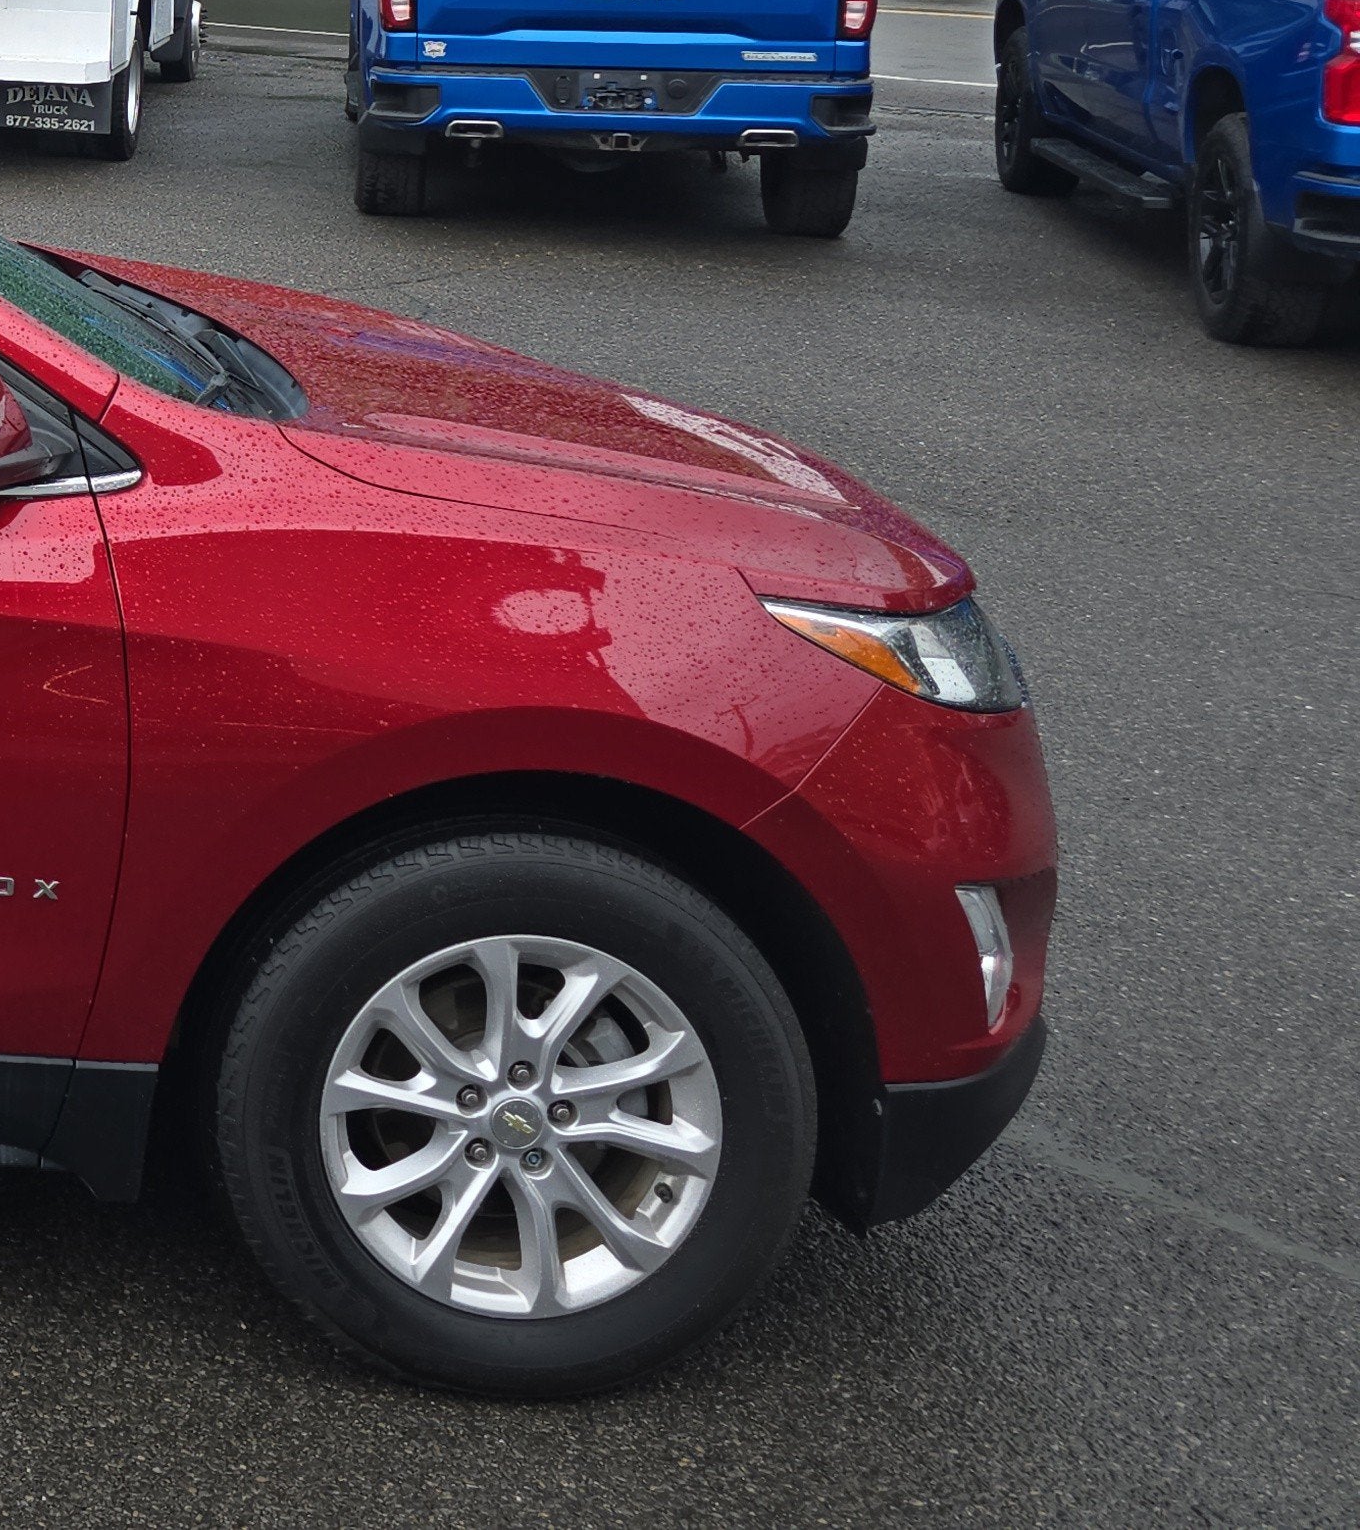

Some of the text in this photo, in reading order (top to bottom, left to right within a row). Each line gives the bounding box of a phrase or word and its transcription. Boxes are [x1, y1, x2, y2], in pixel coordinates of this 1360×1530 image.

[6, 84, 95, 108] DEJANA
[31, 104, 69, 115] TRUCK
[5, 114, 95, 132] 877-335-2621
